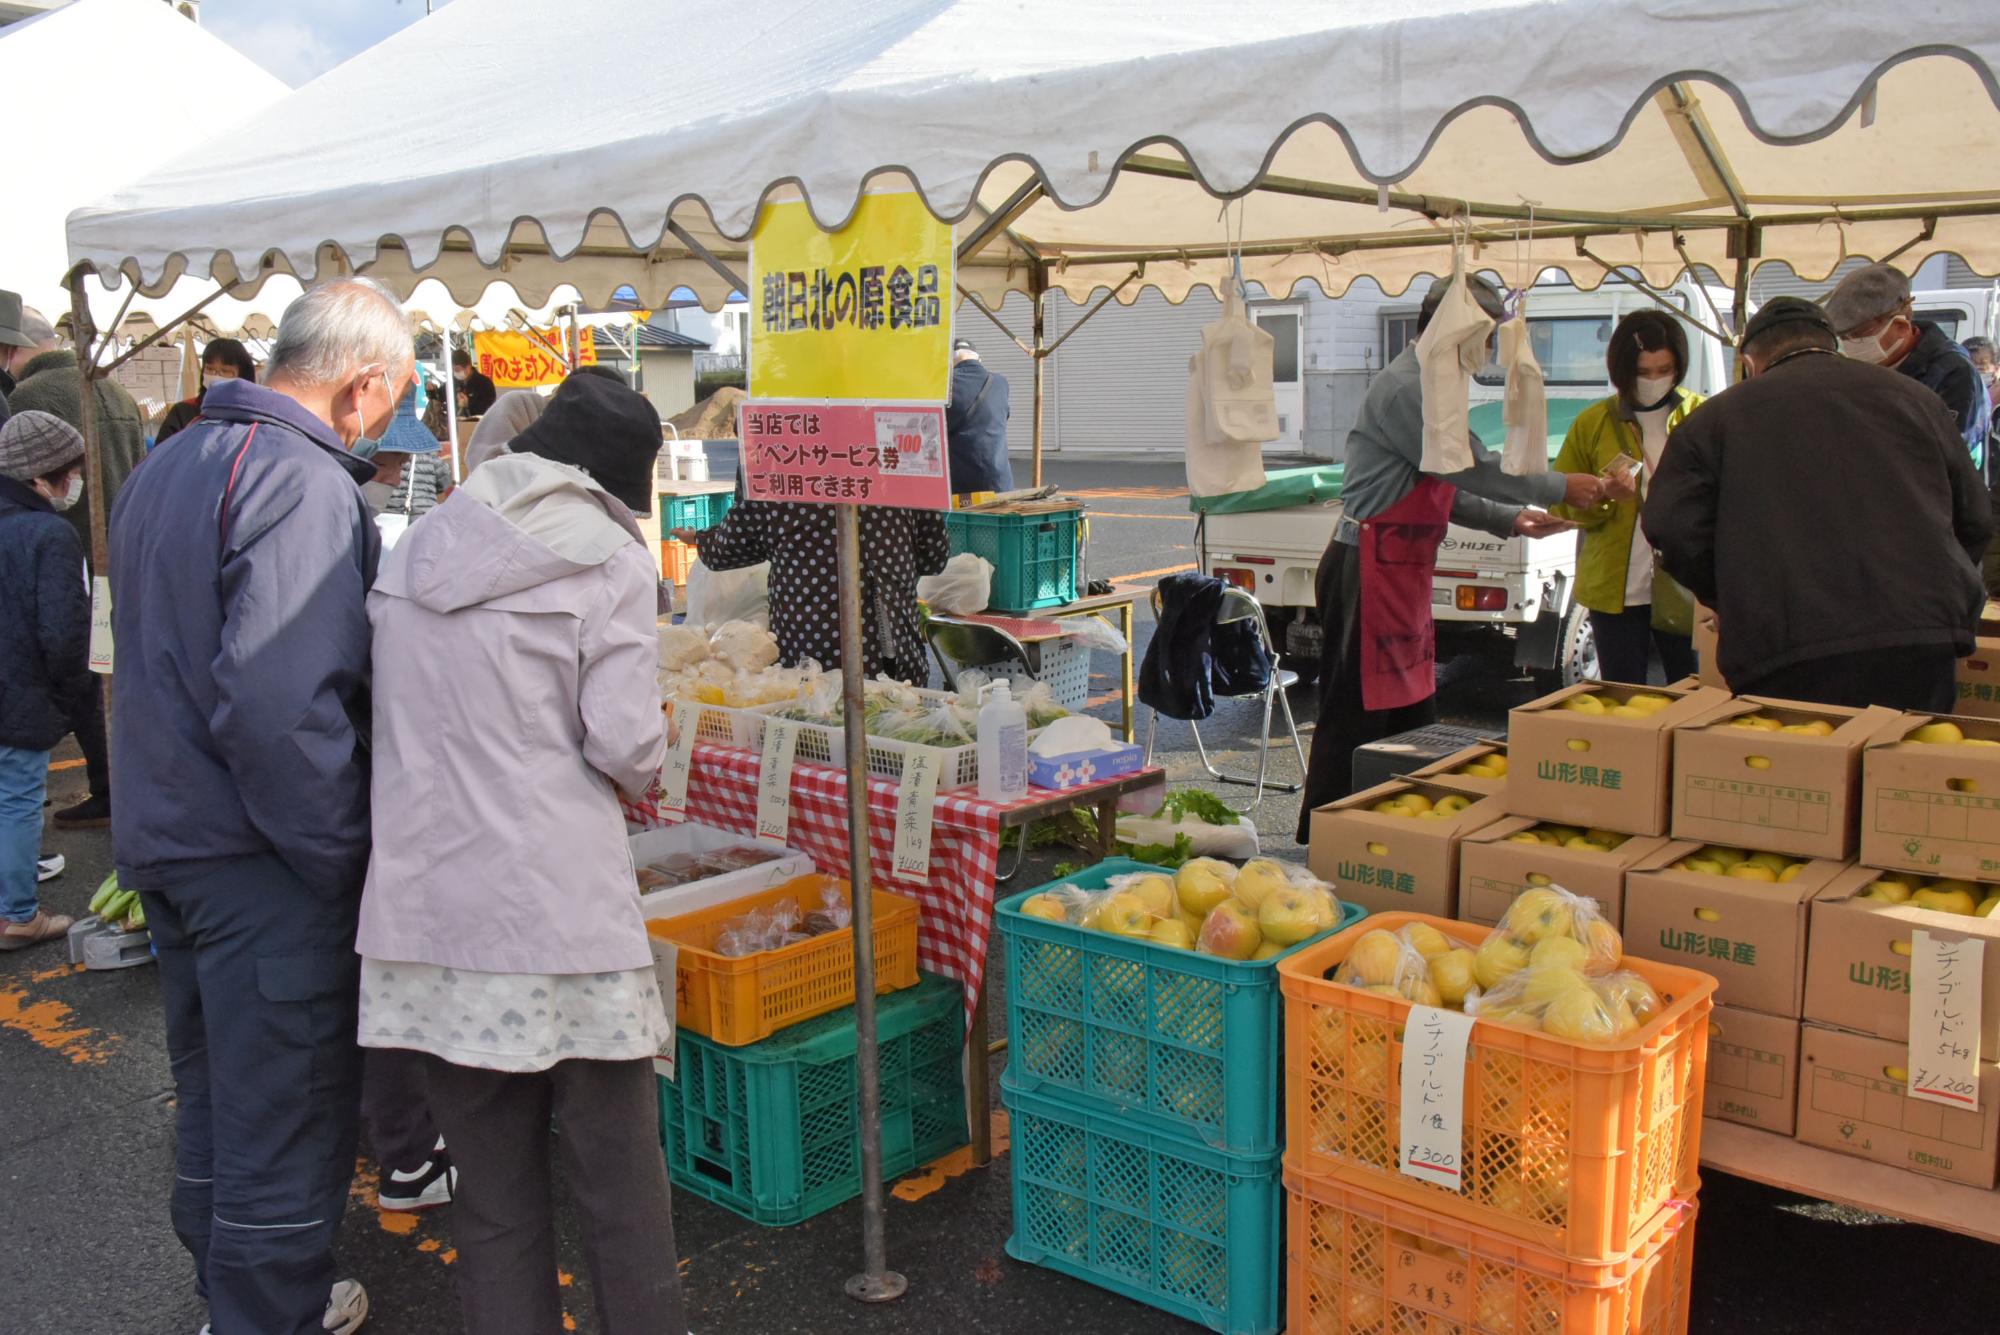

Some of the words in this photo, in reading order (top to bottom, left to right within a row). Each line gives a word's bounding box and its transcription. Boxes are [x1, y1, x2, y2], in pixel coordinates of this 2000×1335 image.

[761, 264, 941, 333] 朝日北の原食品
[749, 413, 820, 435] 当店では
[750, 443, 900, 470] イベントサービス券
[752, 472, 873, 499] ご利用できます
[1460, 541, 1506, 552] HIJET
[1538, 760, 1622, 790] 山形県産
[1338, 860, 1416, 895] 山形県産
[1660, 928, 1756, 966] 山形県産
[1850, 961, 1910, 994] 山形
[1934, 943, 1964, 1036] シナノゴールド
[1421, 1012, 1444, 1105] シナノゴールド
[1937, 1043, 1970, 1060] 5kg
[1408, 1145, 1455, 1166] ¥300
